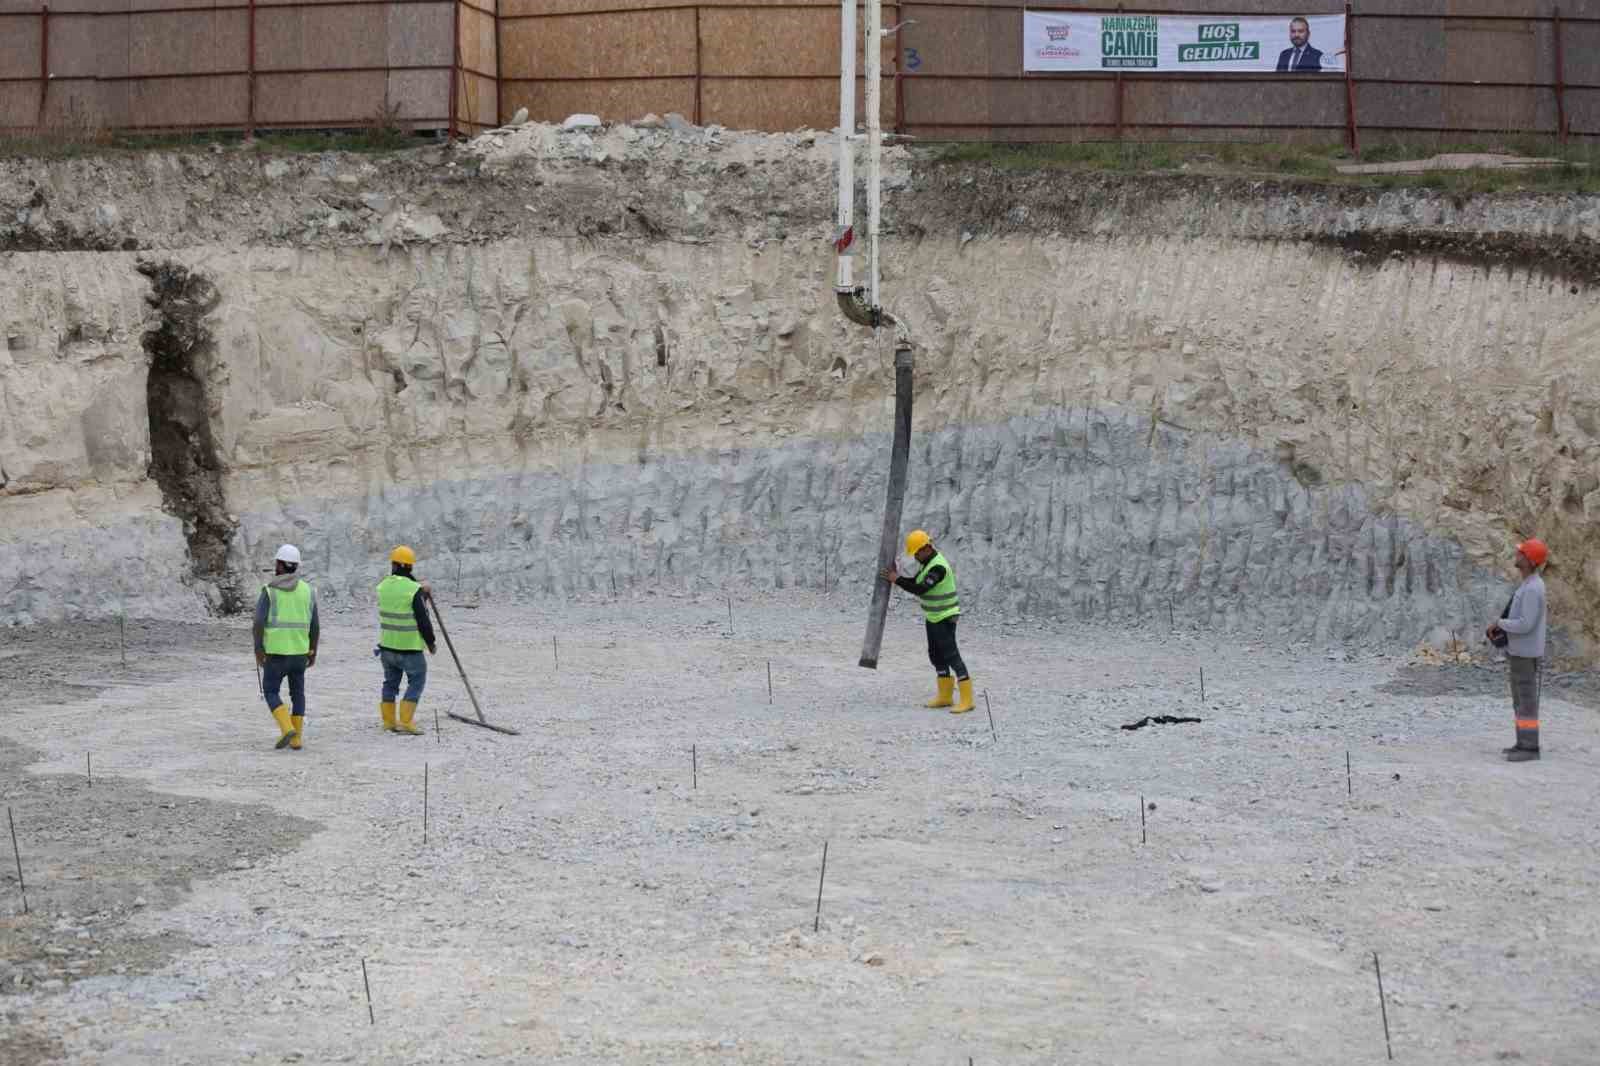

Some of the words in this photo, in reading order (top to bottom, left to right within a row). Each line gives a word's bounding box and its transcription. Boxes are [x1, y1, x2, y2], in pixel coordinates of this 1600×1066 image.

[1202, 25, 1236, 41] HOŞ
[904, 48, 922, 69] 3
[1182, 42, 1256, 60] GELDİNİZ
